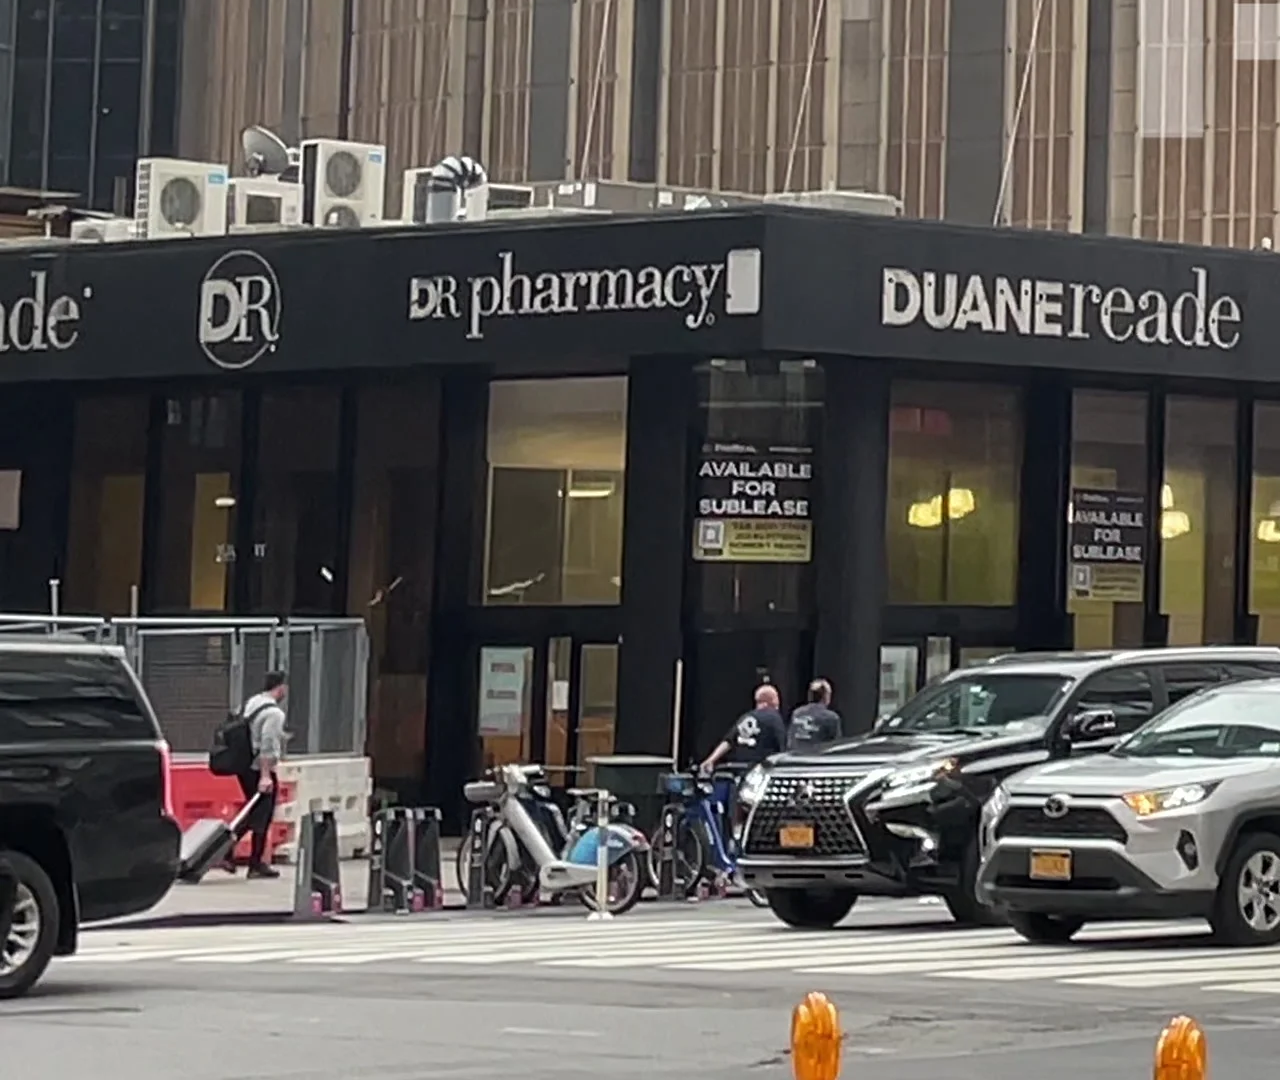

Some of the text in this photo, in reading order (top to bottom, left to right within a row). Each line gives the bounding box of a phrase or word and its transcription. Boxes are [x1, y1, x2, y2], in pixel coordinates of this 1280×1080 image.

[409, 251, 725, 339] DR pharmacy
[0, 270, 80, 353] de
[201, 275, 279, 343] DR
[699, 461, 812, 479] AVAILABLE
[731, 481, 776, 496] FOR
[699, 499, 808, 517] SUBLEASE
[1094, 528, 1121, 543] FOR
